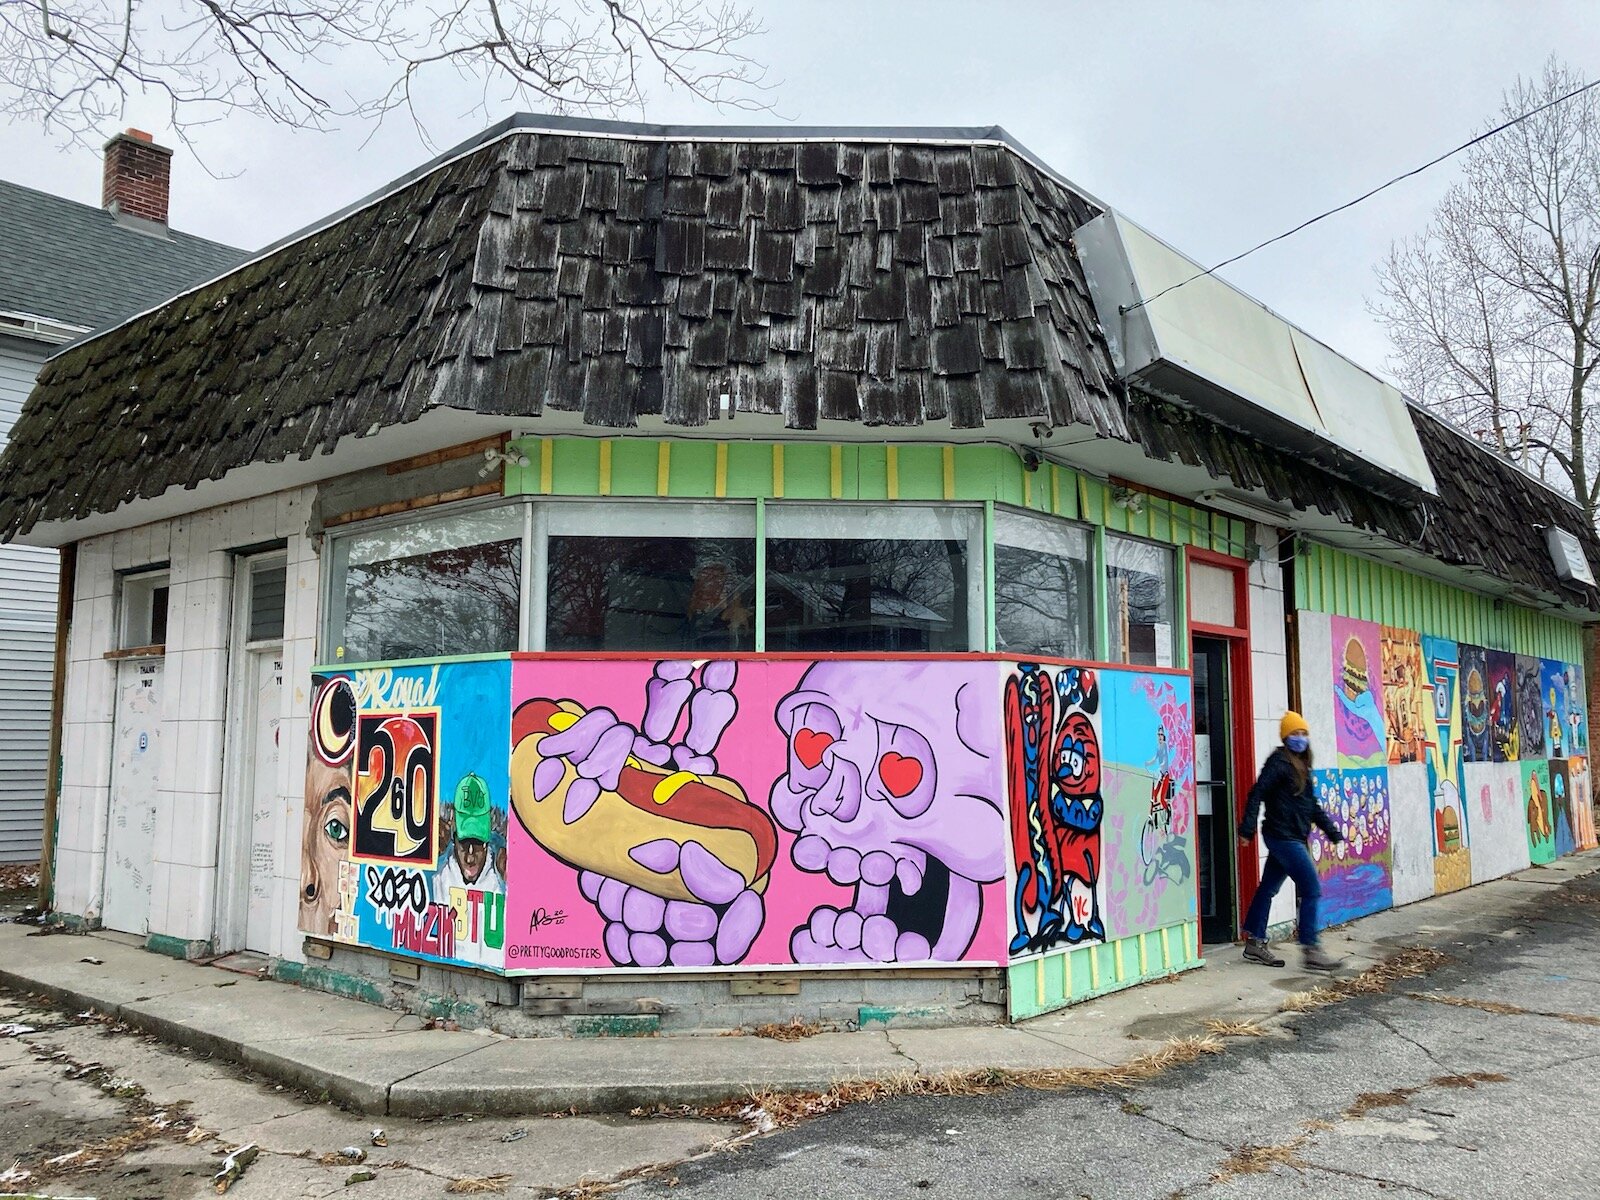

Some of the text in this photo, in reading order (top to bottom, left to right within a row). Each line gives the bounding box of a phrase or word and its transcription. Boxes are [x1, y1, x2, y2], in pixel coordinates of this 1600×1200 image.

[350, 664, 441, 716] Royal
[449, 886, 505, 950] BTU
[508, 944, 602, 959] @PRETTYGOODPOSTERS
